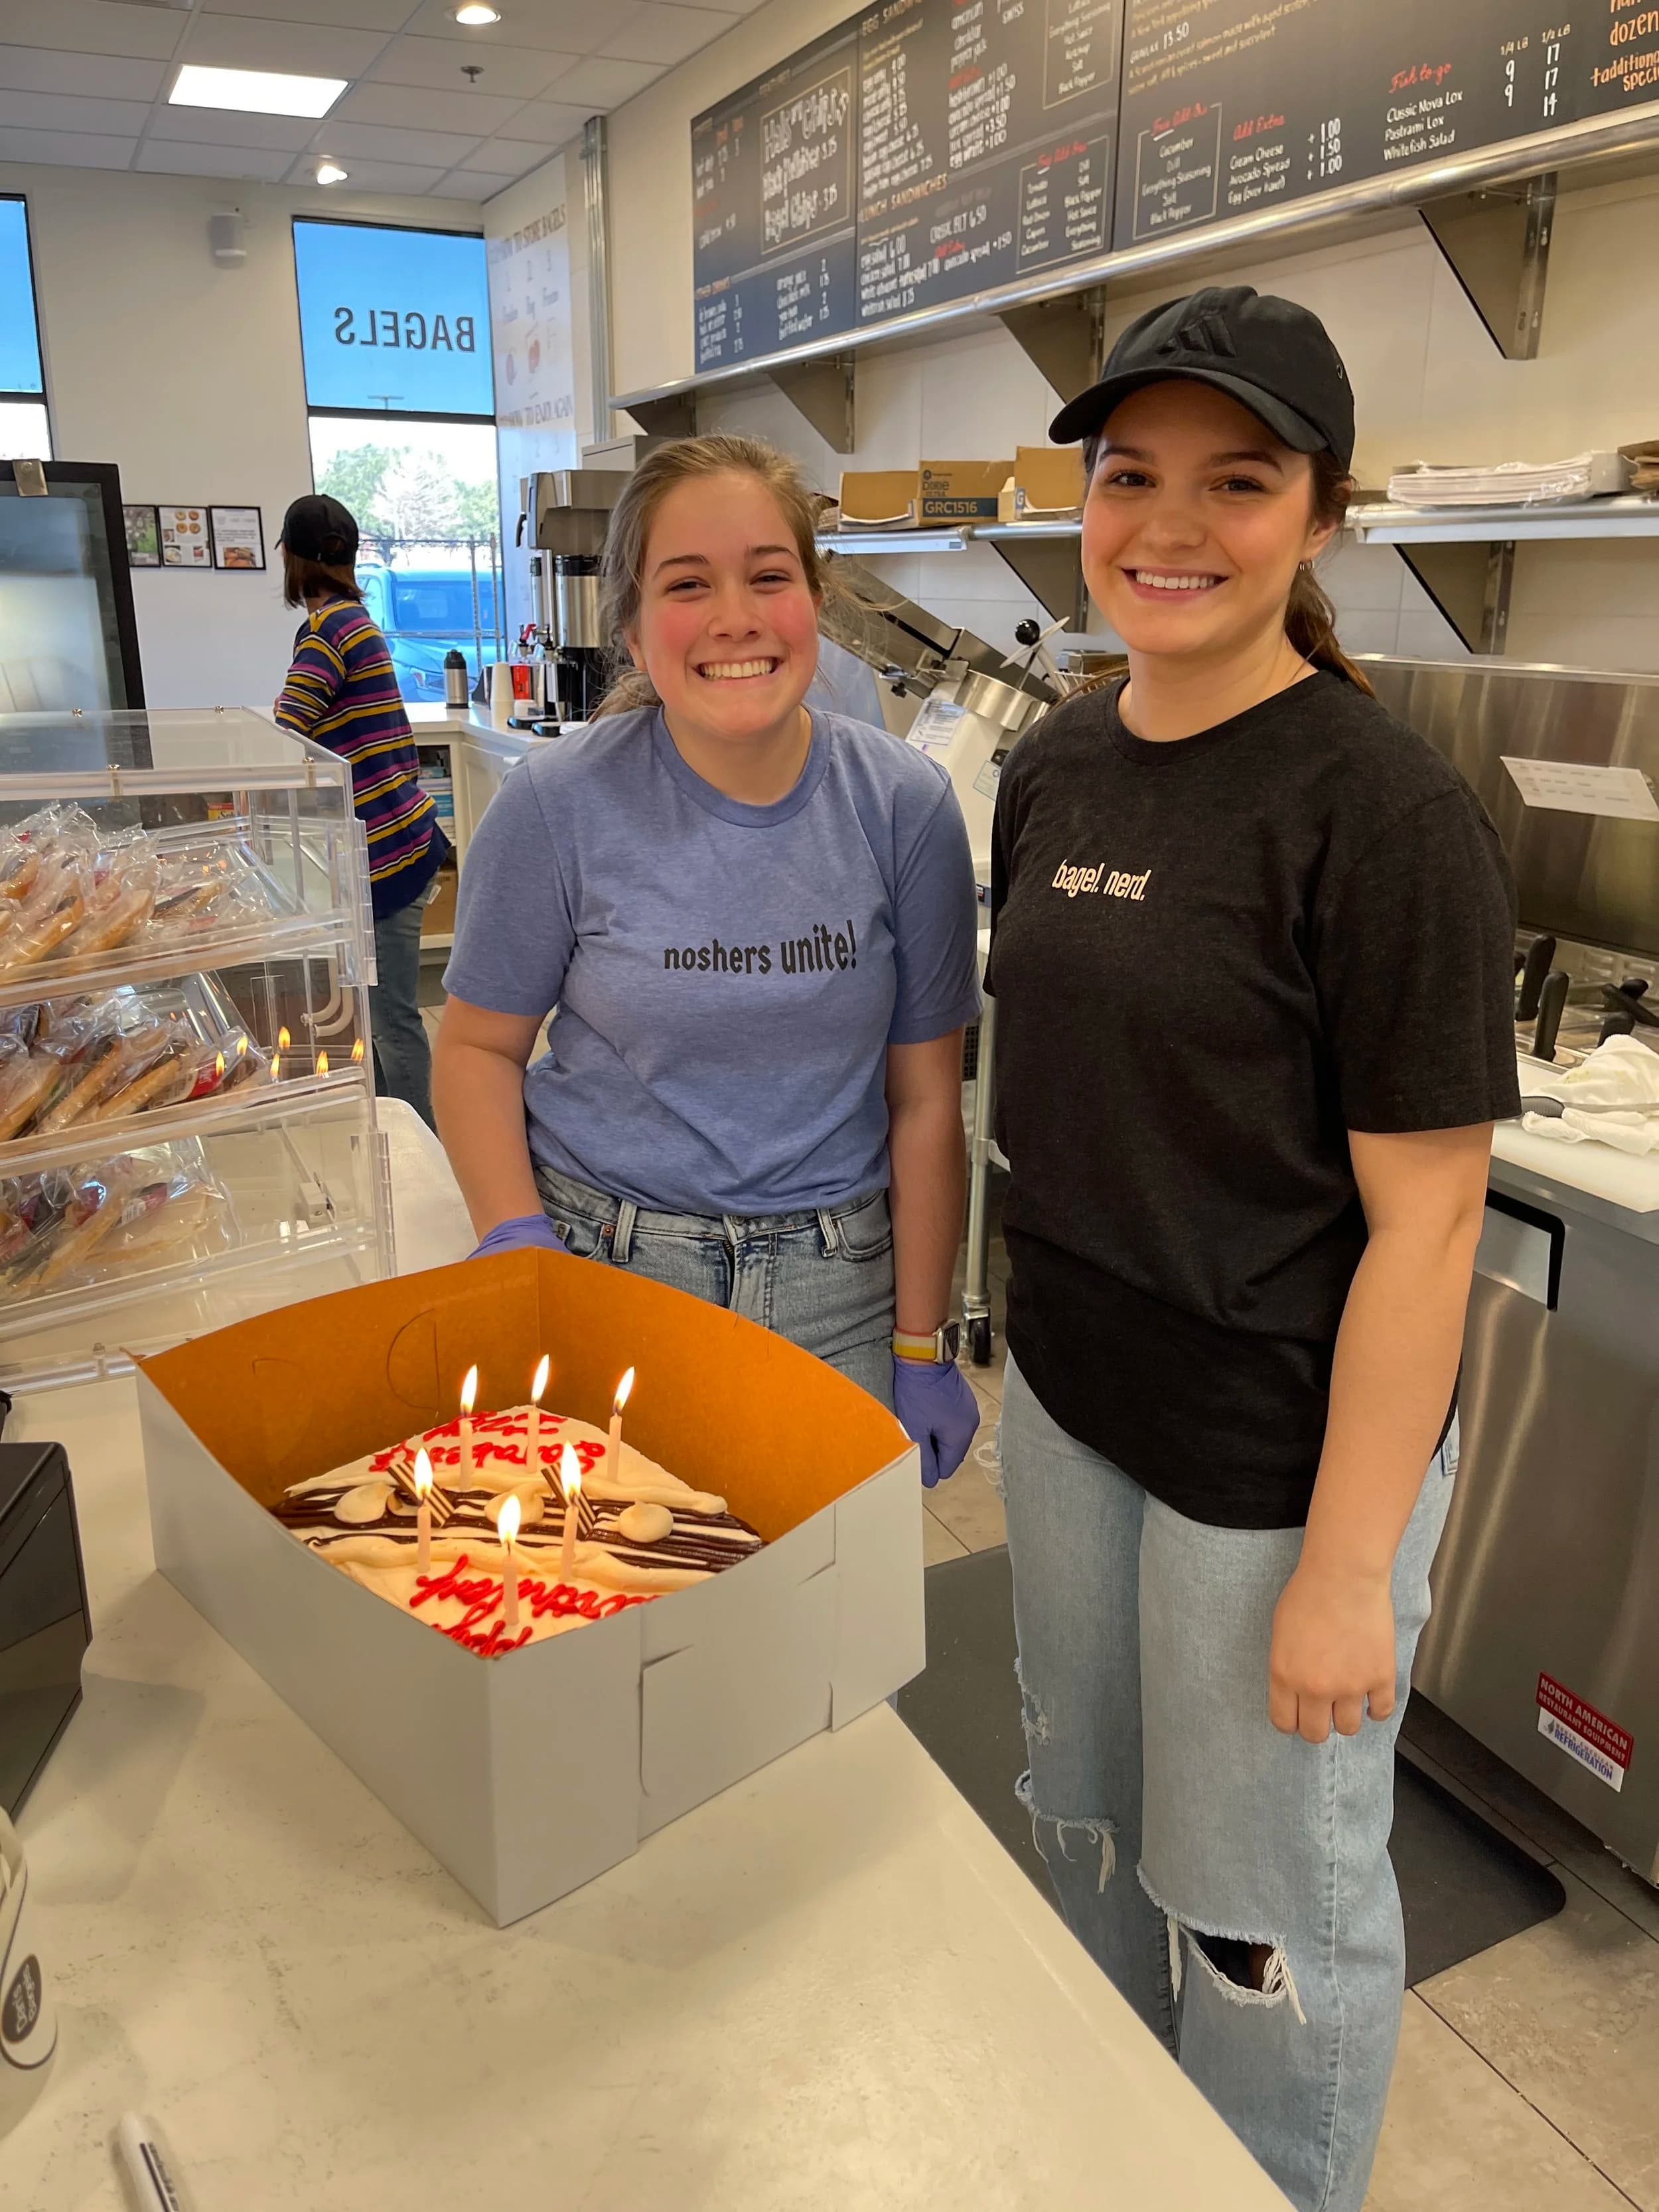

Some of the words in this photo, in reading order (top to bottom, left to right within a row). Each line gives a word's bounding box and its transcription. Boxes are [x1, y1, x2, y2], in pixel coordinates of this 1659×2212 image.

[1517, 37, 1528, 51] LB
[1557, 23, 1571, 37] LB
[1610, 10, 1659, 46] dozen
[1386, 102, 1417, 123] Classic
[1419, 97, 1443, 113] Nova
[1445, 91, 1463, 106] Lox
[1505, 60, 1515, 82] 9
[1547, 42, 1560, 65] 17
[1388, 66, 1417, 94] Fish
[1623, 66, 1659, 92] speci
[1385, 117, 1425, 142] Pastrami
[1427, 115, 1445, 129] Lox
[1504, 84, 1513, 107] 9
[1544, 67, 1559, 90] 17
[1230, 155, 1254, 170] Cream
[1255, 145, 1284, 162] Cheese
[1321, 117, 1341, 143] 1.00
[1320, 138, 1341, 160] 1.50
[1428, 129, 1455, 149] Salad
[1320, 155, 1342, 177] 1.00
[924, 501, 977, 514] GRC1516
[1103, 869, 1152, 901] nerd.
[664, 938, 772, 974] noshers
[780, 919, 857, 974] unite!
[1538, 1691, 1583, 1730] RESTAURANT
[1583, 1726, 1626, 1761] EQUIPMENT
[1540, 1678, 1573, 1710] NORTH
[1575, 1705, 1628, 1750] AMERICAN
[1554, 1730, 1613, 1781] REFRIGERATION
